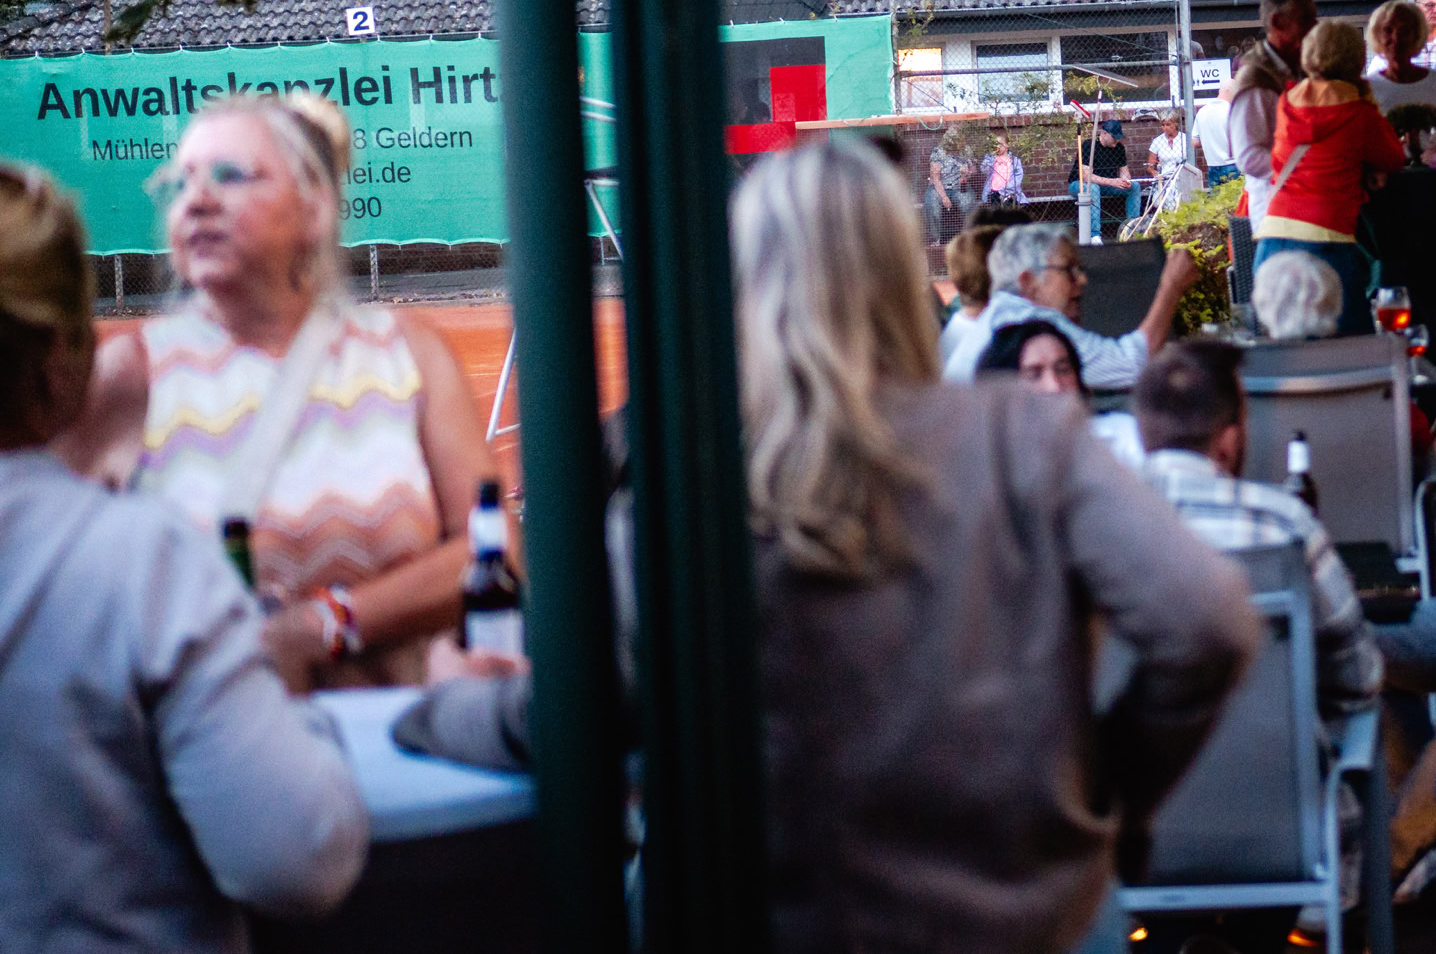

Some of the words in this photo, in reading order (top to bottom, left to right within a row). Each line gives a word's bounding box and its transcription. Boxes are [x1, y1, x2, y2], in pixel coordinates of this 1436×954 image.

[353, 11, 370, 31] 2
[1200, 68, 1220, 78] WC
[37, 65, 393, 120] Anwaltskanzlei
[410, 65, 502, 104] Hirt
[92, 137, 179, 161] Mühlen
[376, 126, 473, 149] Geldern
